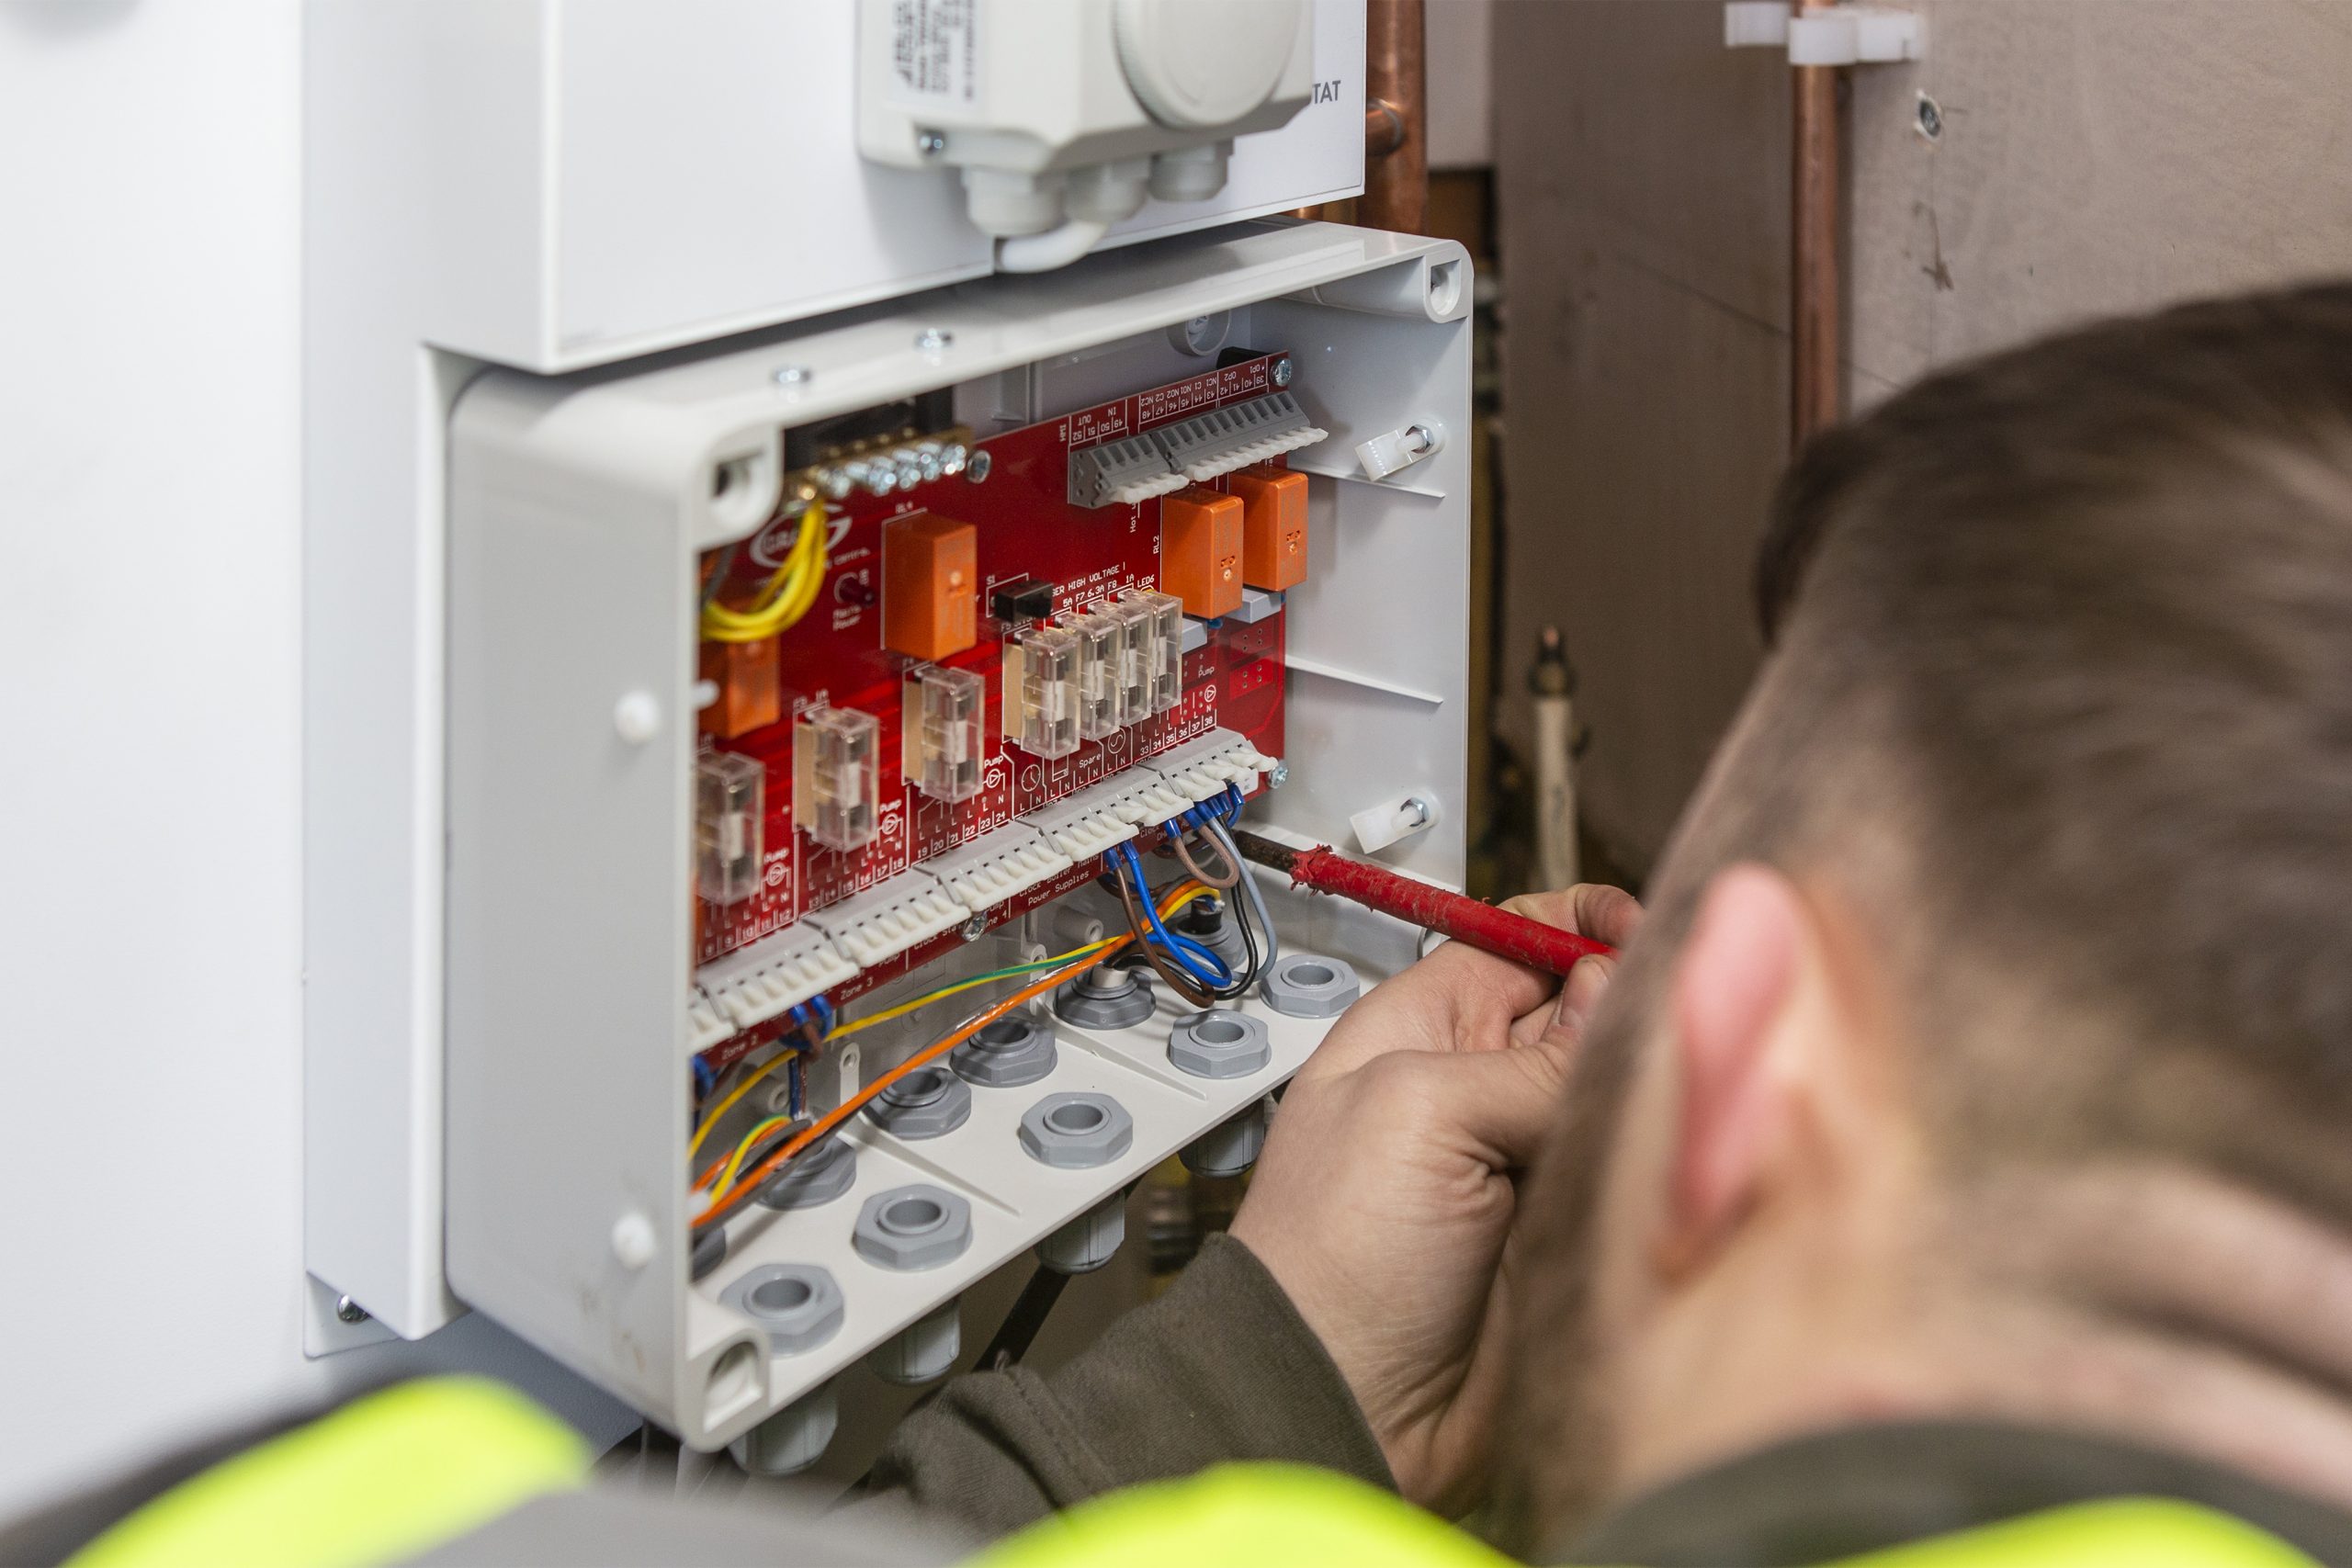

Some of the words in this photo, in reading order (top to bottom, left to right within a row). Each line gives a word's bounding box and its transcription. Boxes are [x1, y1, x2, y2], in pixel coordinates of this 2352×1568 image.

[1250, 364, 1261, 374] OP1
[1224, 371, 1237, 381] OP2
[1194, 381, 1202, 389] C1
[1206, 377, 1217, 387] NC1
[1233, 383, 1239, 391] 41
[1244, 379, 1252, 388] 40
[1206, 390, 1215, 399] 43
[1220, 387, 1228, 396] 42
[1140, 397, 1154, 407] NC2
[1155, 392, 1164, 402] C2
[1181, 397, 1190, 407] 45
[1194, 394, 1203, 402] 44
[1107, 406, 1116, 417] IN
[1156, 406, 1164, 415] 47
[1169, 402, 1177, 412] 46
[1078, 414, 1091, 426] OUT
[1142, 411, 1151, 420] 48
[1101, 423, 1110, 432] 50
[1114, 419, 1123, 428] 49
[1073, 431, 1082, 441] 52
[1088, 426, 1095, 436] 51
[1069, 575, 1086, 591] HIGH
[1089, 564, 1120, 582] VOLTAGE
[1125, 574, 1134, 584] 1A
[1137, 574, 1155, 588] LED6
[1108, 581, 1117, 591] F8
[1076, 590, 1085, 602] F7
[1087, 582, 1105, 598] 6.3A
[1198, 666, 1215, 679] Pump
[1205, 705, 1212, 713] N
[1140, 745, 1149, 756] 33
[1153, 739, 1161, 750] 34
[1166, 734, 1174, 744] 35
[1179, 728, 1188, 738] 36
[1192, 722, 1200, 732] 37
[1204, 716, 1213, 727] 38
[984, 755, 1004, 769] Pump
[1079, 753, 1102, 769] Spare
[1107, 763, 1113, 772] L
[1120, 757, 1125, 765] N
[1080, 775, 1084, 784] L
[1092, 769, 1098, 777] N
[1050, 789, 1056, 797] L
[1065, 783, 1070, 791] N
[998, 795, 1004, 805] N
[1020, 803, 1025, 812] L
[1035, 795, 1041, 805] N
[918, 847, 928, 859] 19
[933, 840, 944, 851] 20
[950, 832, 958, 843] 21
[965, 826, 975, 837] 22
[980, 818, 990, 829] 23
[996, 811, 1006, 823] 24
[895, 840, 902, 852] N
[860, 874, 871, 886] 16
[876, 864, 888, 877] 17
[1028, 889, 1050, 907] Power
[1055, 871, 1090, 892] Supplies
[1002, 909, 1007, 919] 4
[840, 984, 863, 1000] Zone
[867, 976, 874, 987] 3
